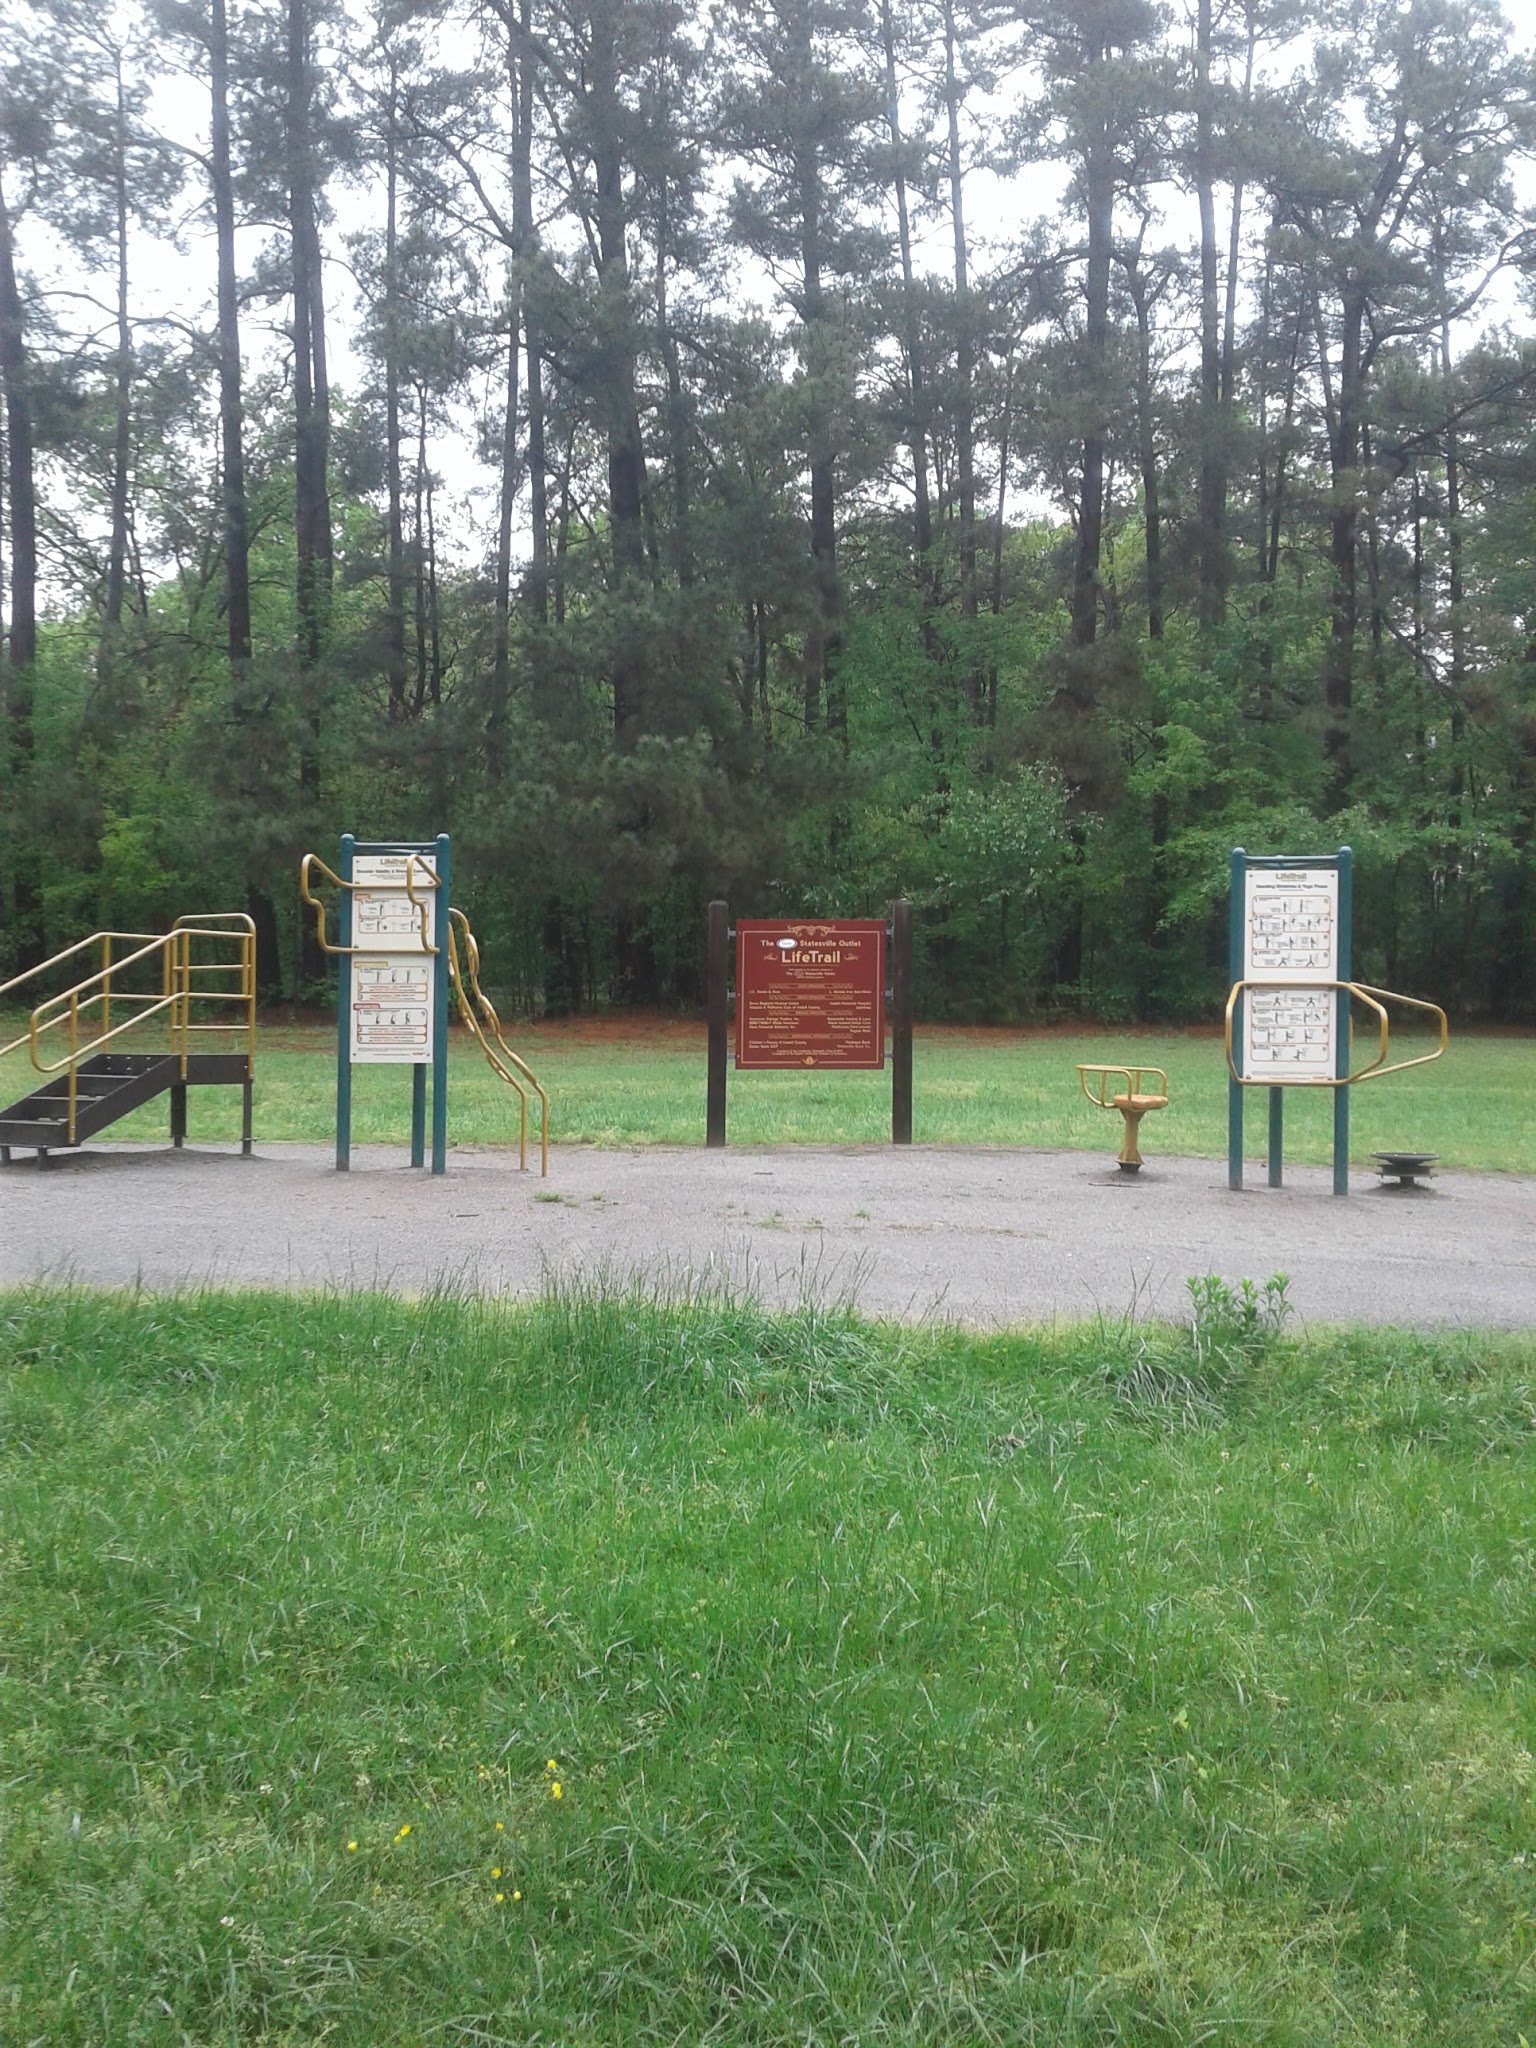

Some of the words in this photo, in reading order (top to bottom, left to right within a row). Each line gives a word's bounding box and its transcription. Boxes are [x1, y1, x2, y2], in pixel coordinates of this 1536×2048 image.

[760, 939, 774, 947] The
[800, 939, 837, 947] Statesville
[781, 950, 841, 963] LifeTrail
